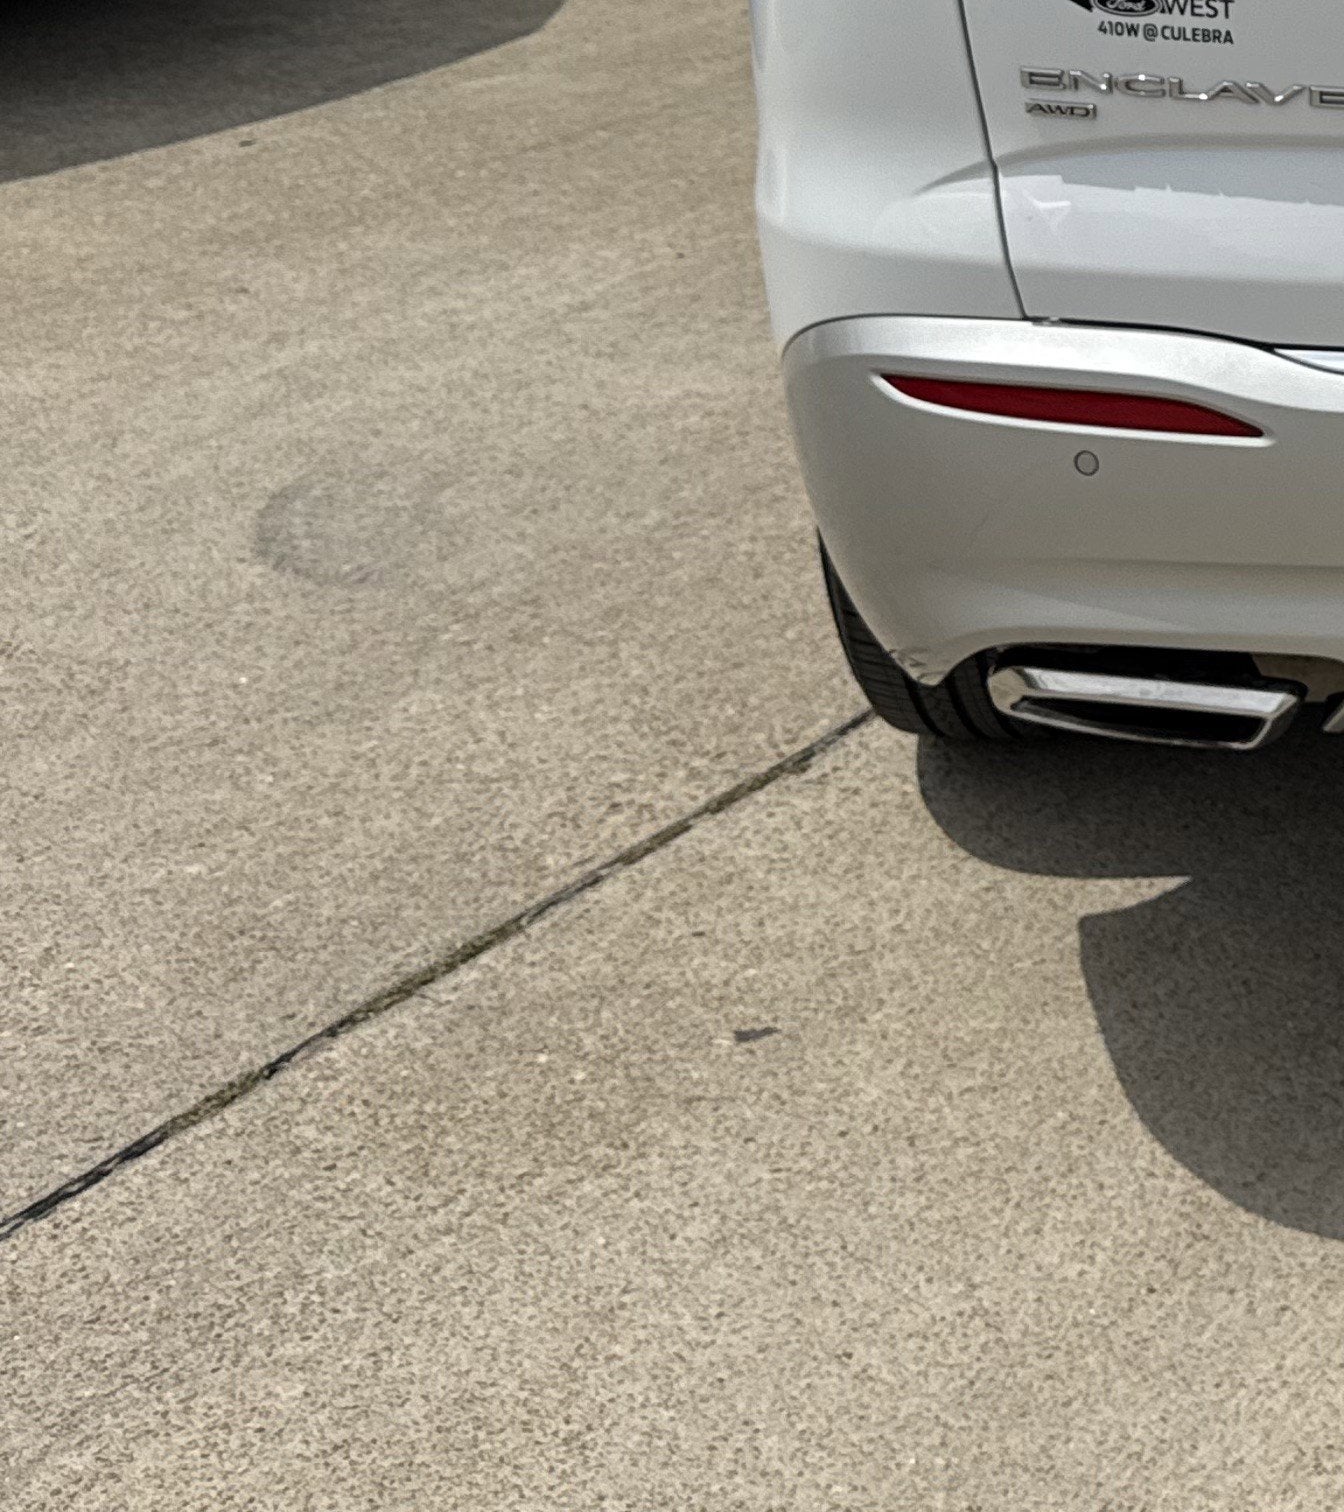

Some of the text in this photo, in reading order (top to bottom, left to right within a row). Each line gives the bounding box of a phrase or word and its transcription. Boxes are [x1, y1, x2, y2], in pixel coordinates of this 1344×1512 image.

[1097, 20, 1234, 45] 410W @ CULEBRA
[1025, 99, 1097, 120] AWD
